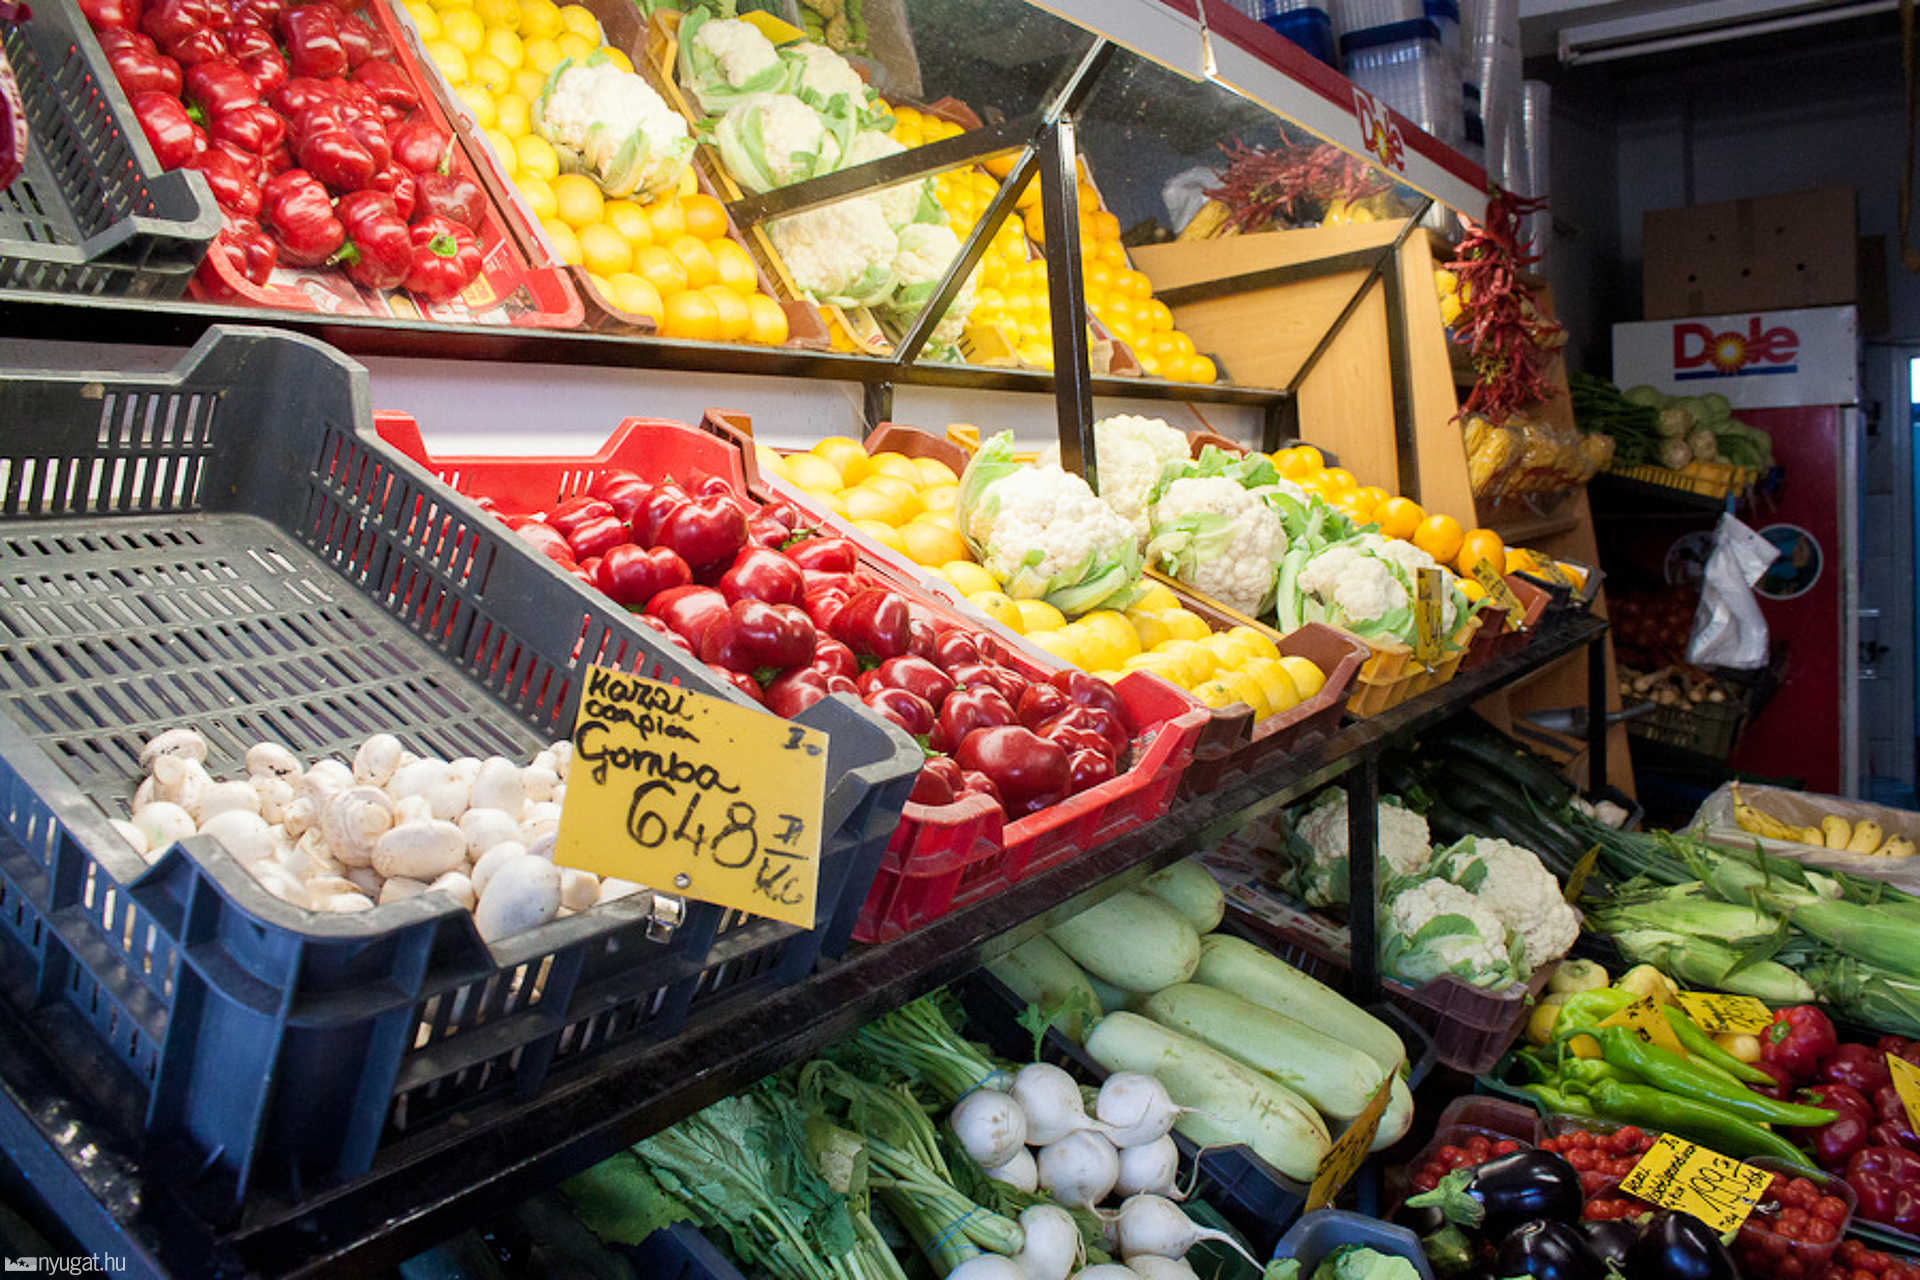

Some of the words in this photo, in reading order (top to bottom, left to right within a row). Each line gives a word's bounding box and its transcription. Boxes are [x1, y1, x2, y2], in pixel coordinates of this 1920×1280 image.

[1352, 86, 1404, 171] Dole
[1673, 316, 1799, 374] Dole
[575, 720, 741, 794] Gomba
[626, 779, 759, 869] 648
